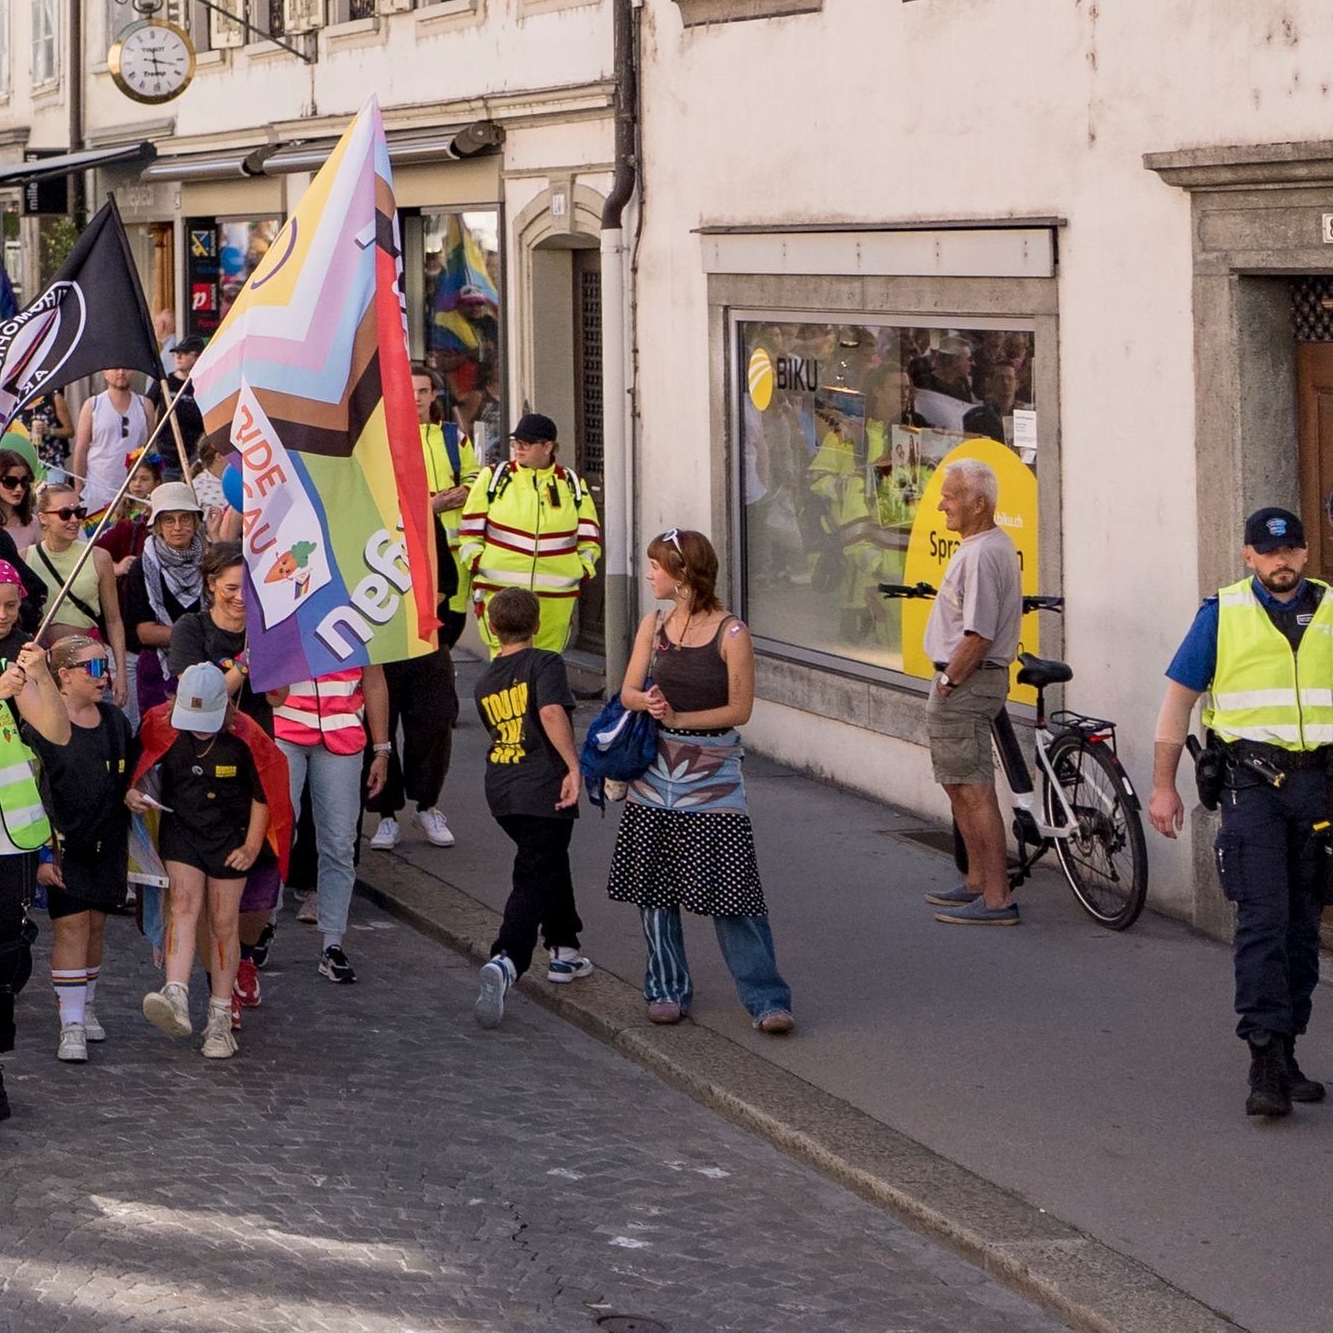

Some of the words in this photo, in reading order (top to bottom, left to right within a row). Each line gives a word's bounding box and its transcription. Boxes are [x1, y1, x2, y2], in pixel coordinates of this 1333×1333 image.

[776, 357, 819, 391] BIKU
[236, 405, 287, 497] RIDE
[481, 682, 528, 726] TOUCH
